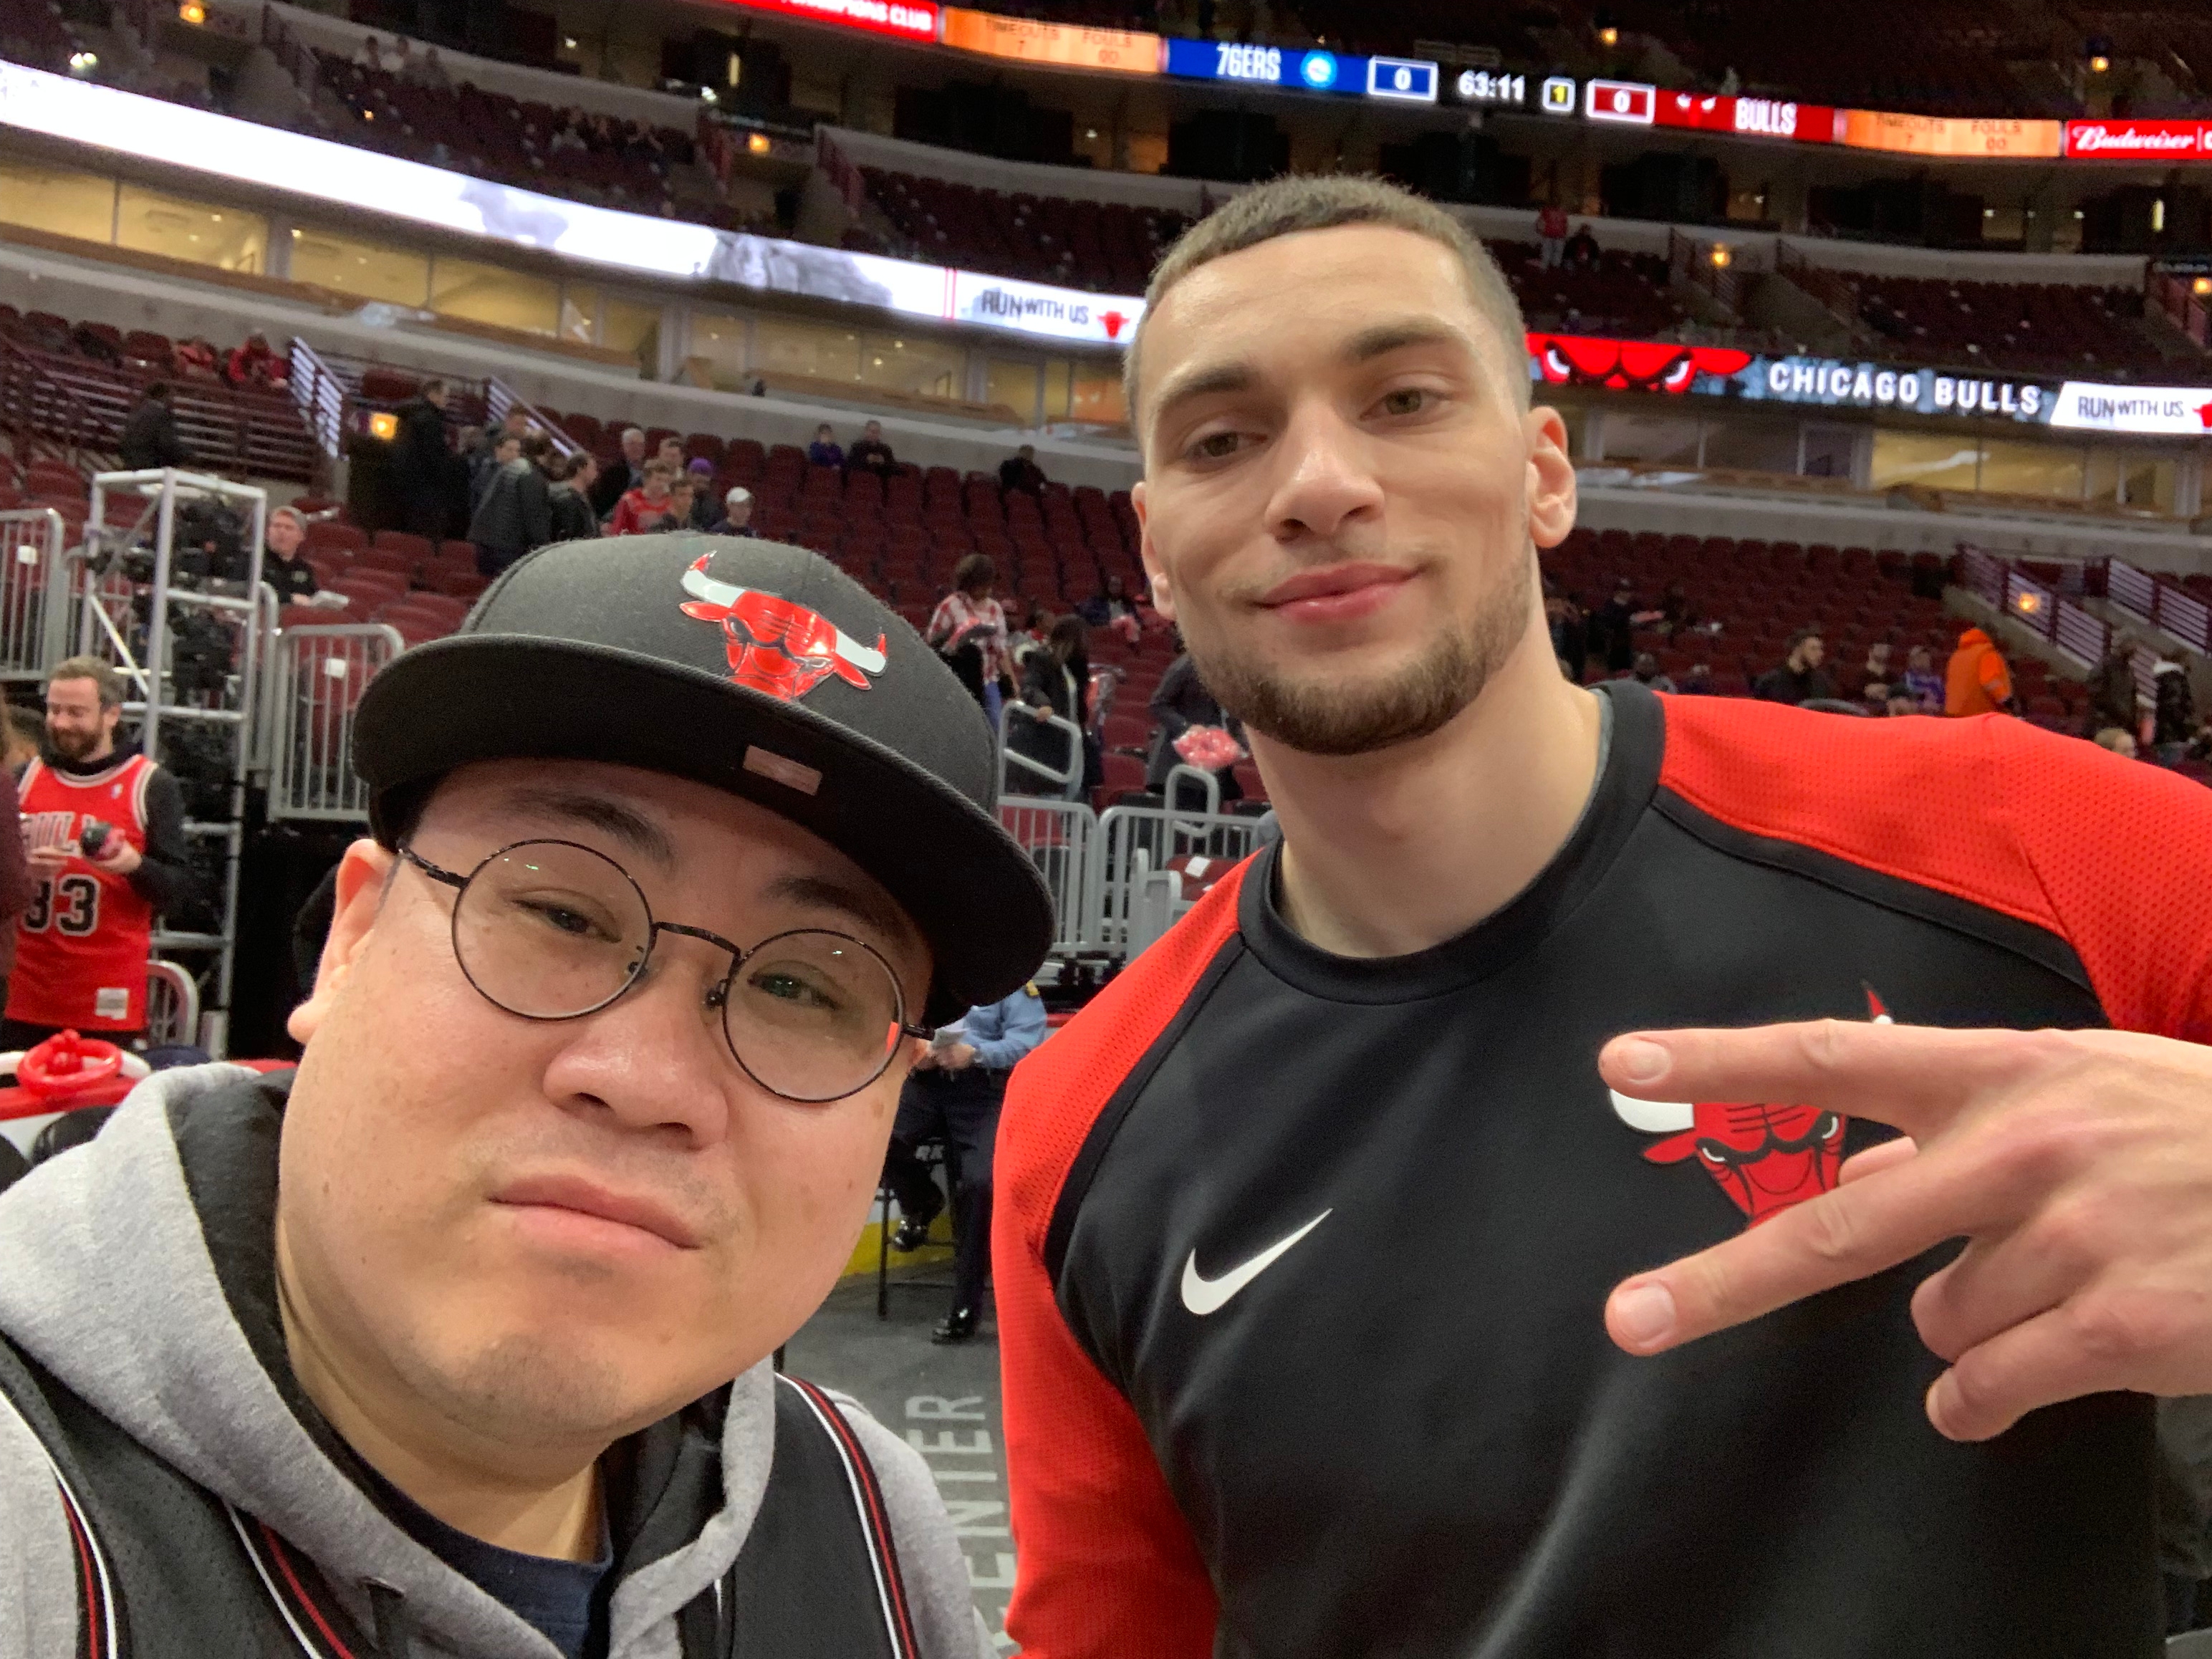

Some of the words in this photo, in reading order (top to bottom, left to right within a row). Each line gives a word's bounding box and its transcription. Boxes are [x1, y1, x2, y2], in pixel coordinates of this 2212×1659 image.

[889, 5, 932, 31] CLUB
[1217, 44, 1281, 81] 76ERS
[1395, 67, 1411, 90] 0
[1458, 70, 1525, 102] 63:11
[1553, 85, 1567, 104] 1
[1613, 89, 1631, 113] 0
[1735, 97, 1797, 135] BULLS
[2072, 125, 2194, 151] Budweiser
[981, 288, 1023, 322] RUN
[1024, 298, 1064, 319] WITH
[1069, 304, 1090, 324] US
[1769, 362, 1920, 404] CHICAGO
[1934, 376, 2041, 415] BULLS
[2077, 395, 2115, 419] RUN
[2117, 398, 2158, 417] WITH
[2163, 400, 2185, 418] US
